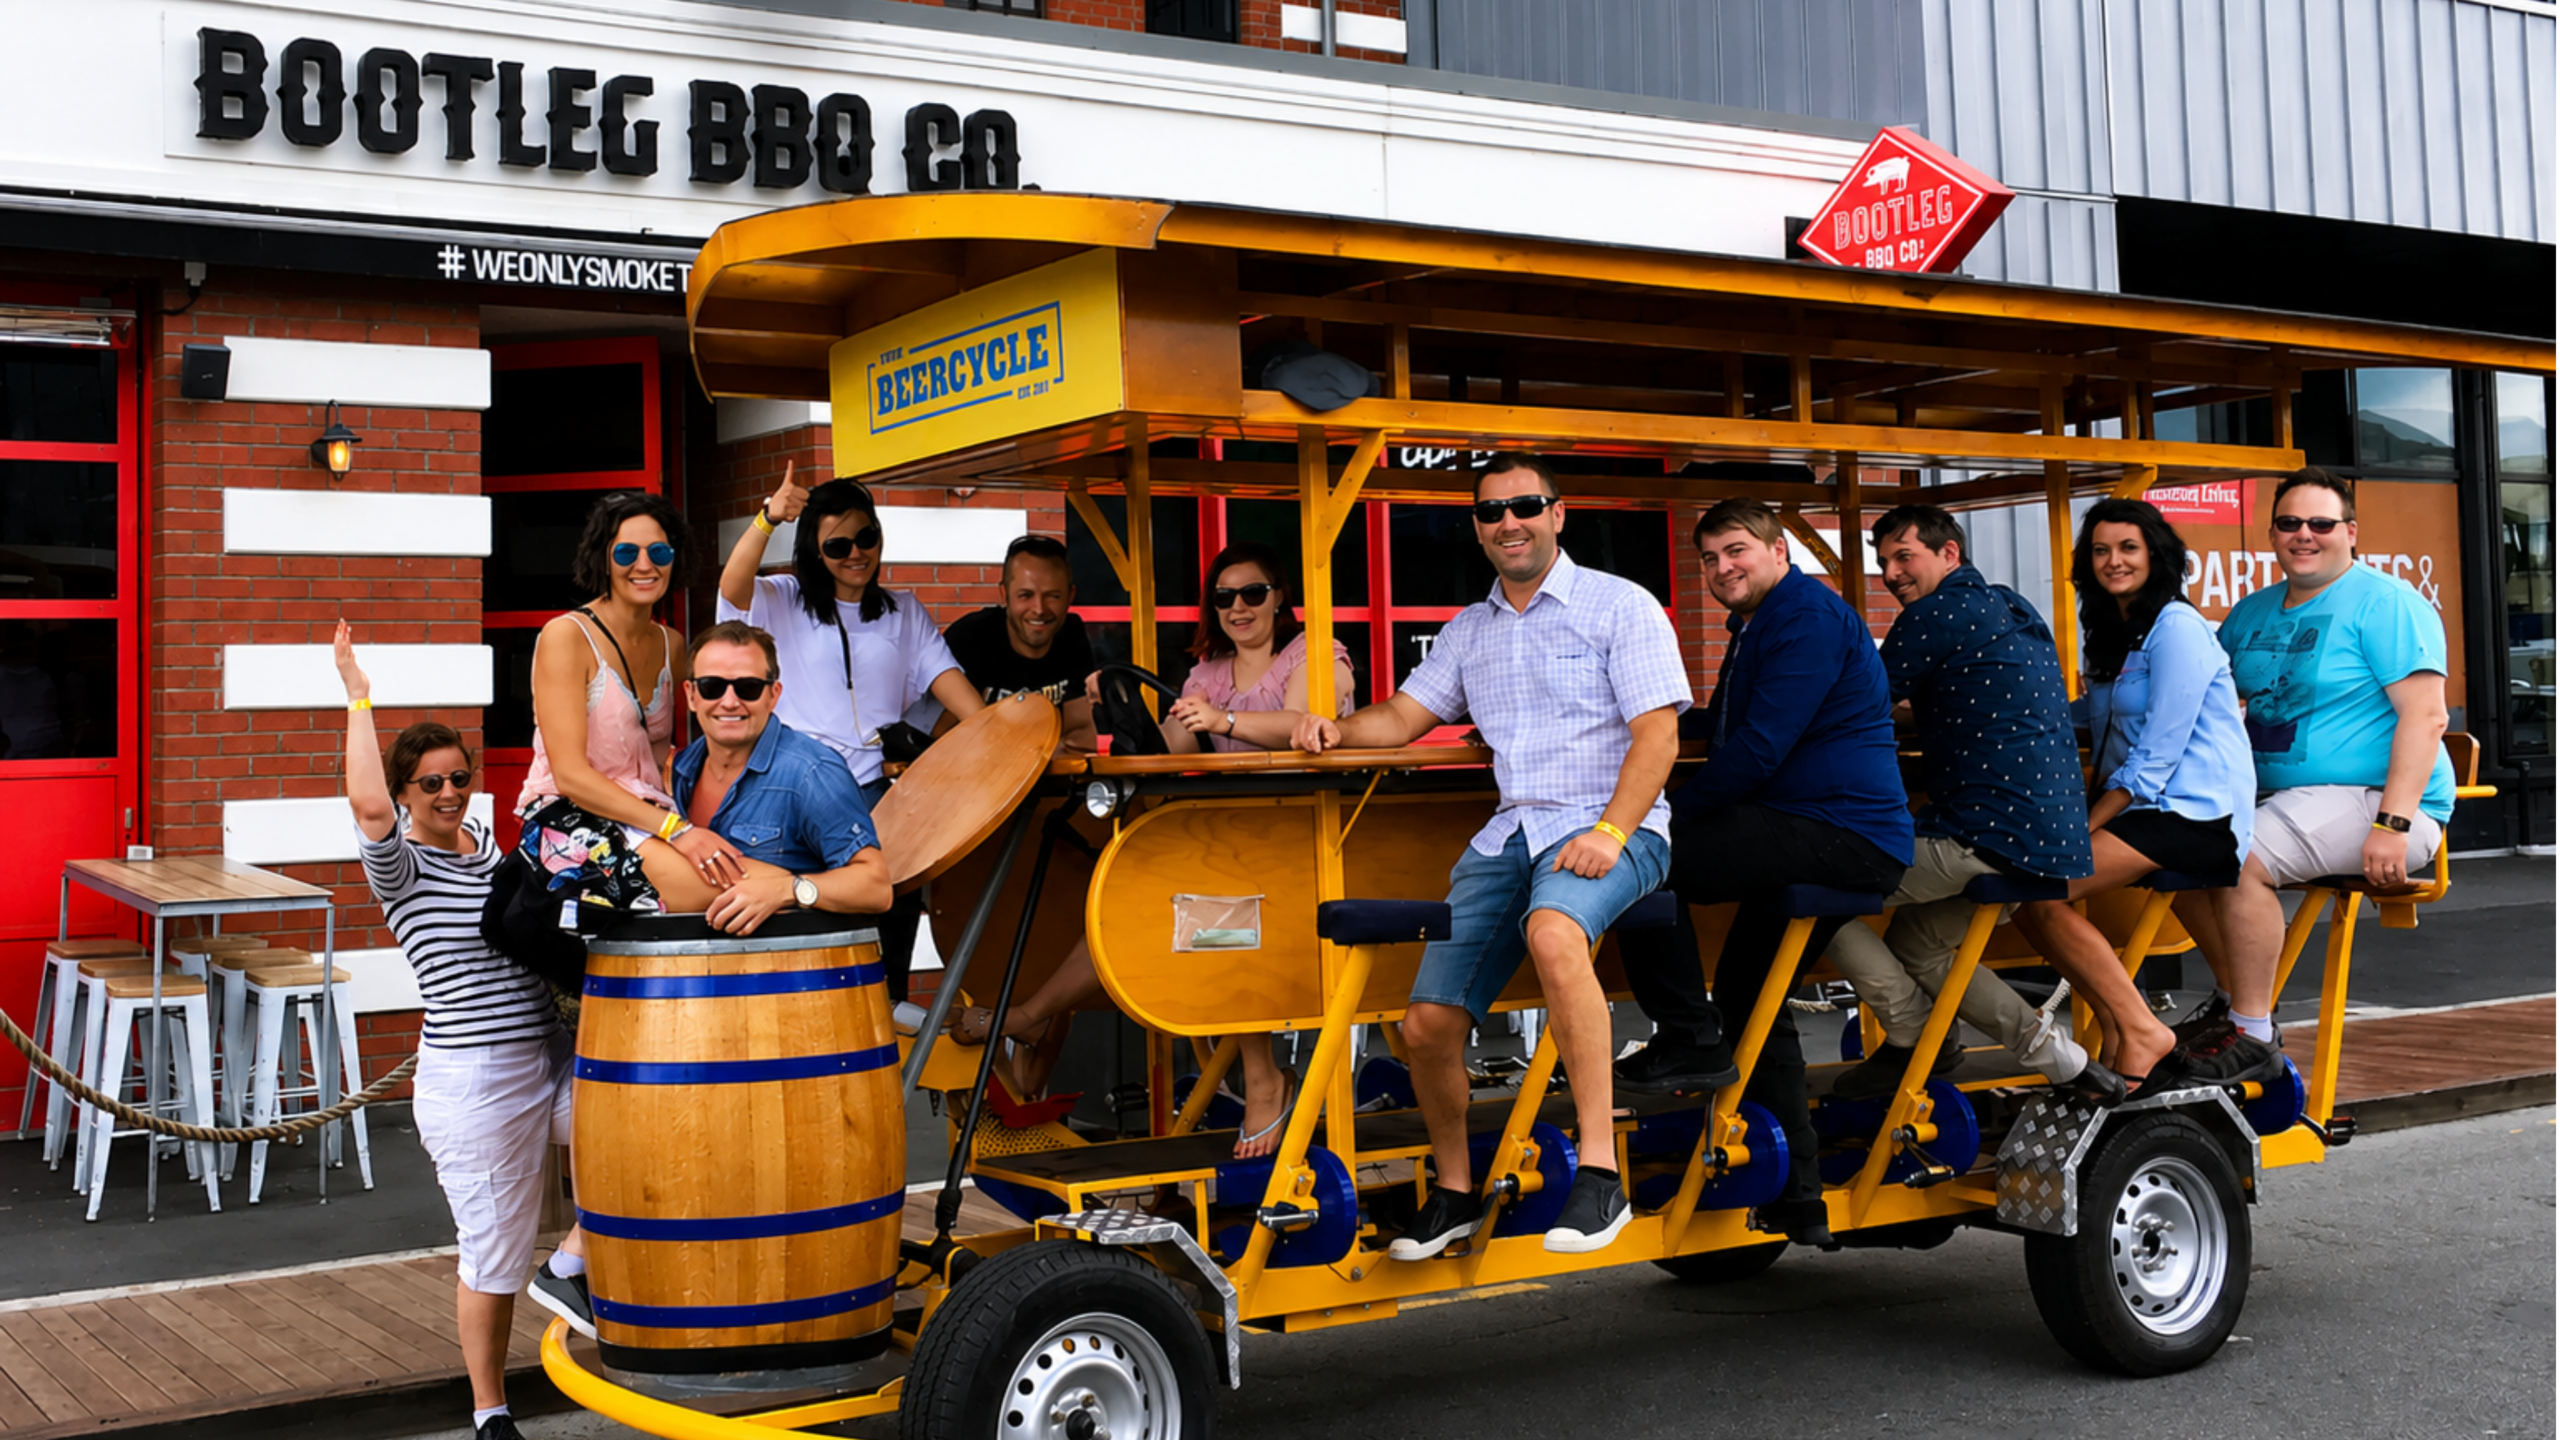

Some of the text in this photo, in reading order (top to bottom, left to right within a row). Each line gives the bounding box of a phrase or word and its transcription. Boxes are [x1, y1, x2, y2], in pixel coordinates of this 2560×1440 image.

[194, 27, 660, 177] BOOTLEG
[687, 79, 875, 195] BBQ
[1833, 185, 1952, 250] BOOTLEG
[876, 323, 1049, 416] BEERCYCLE
